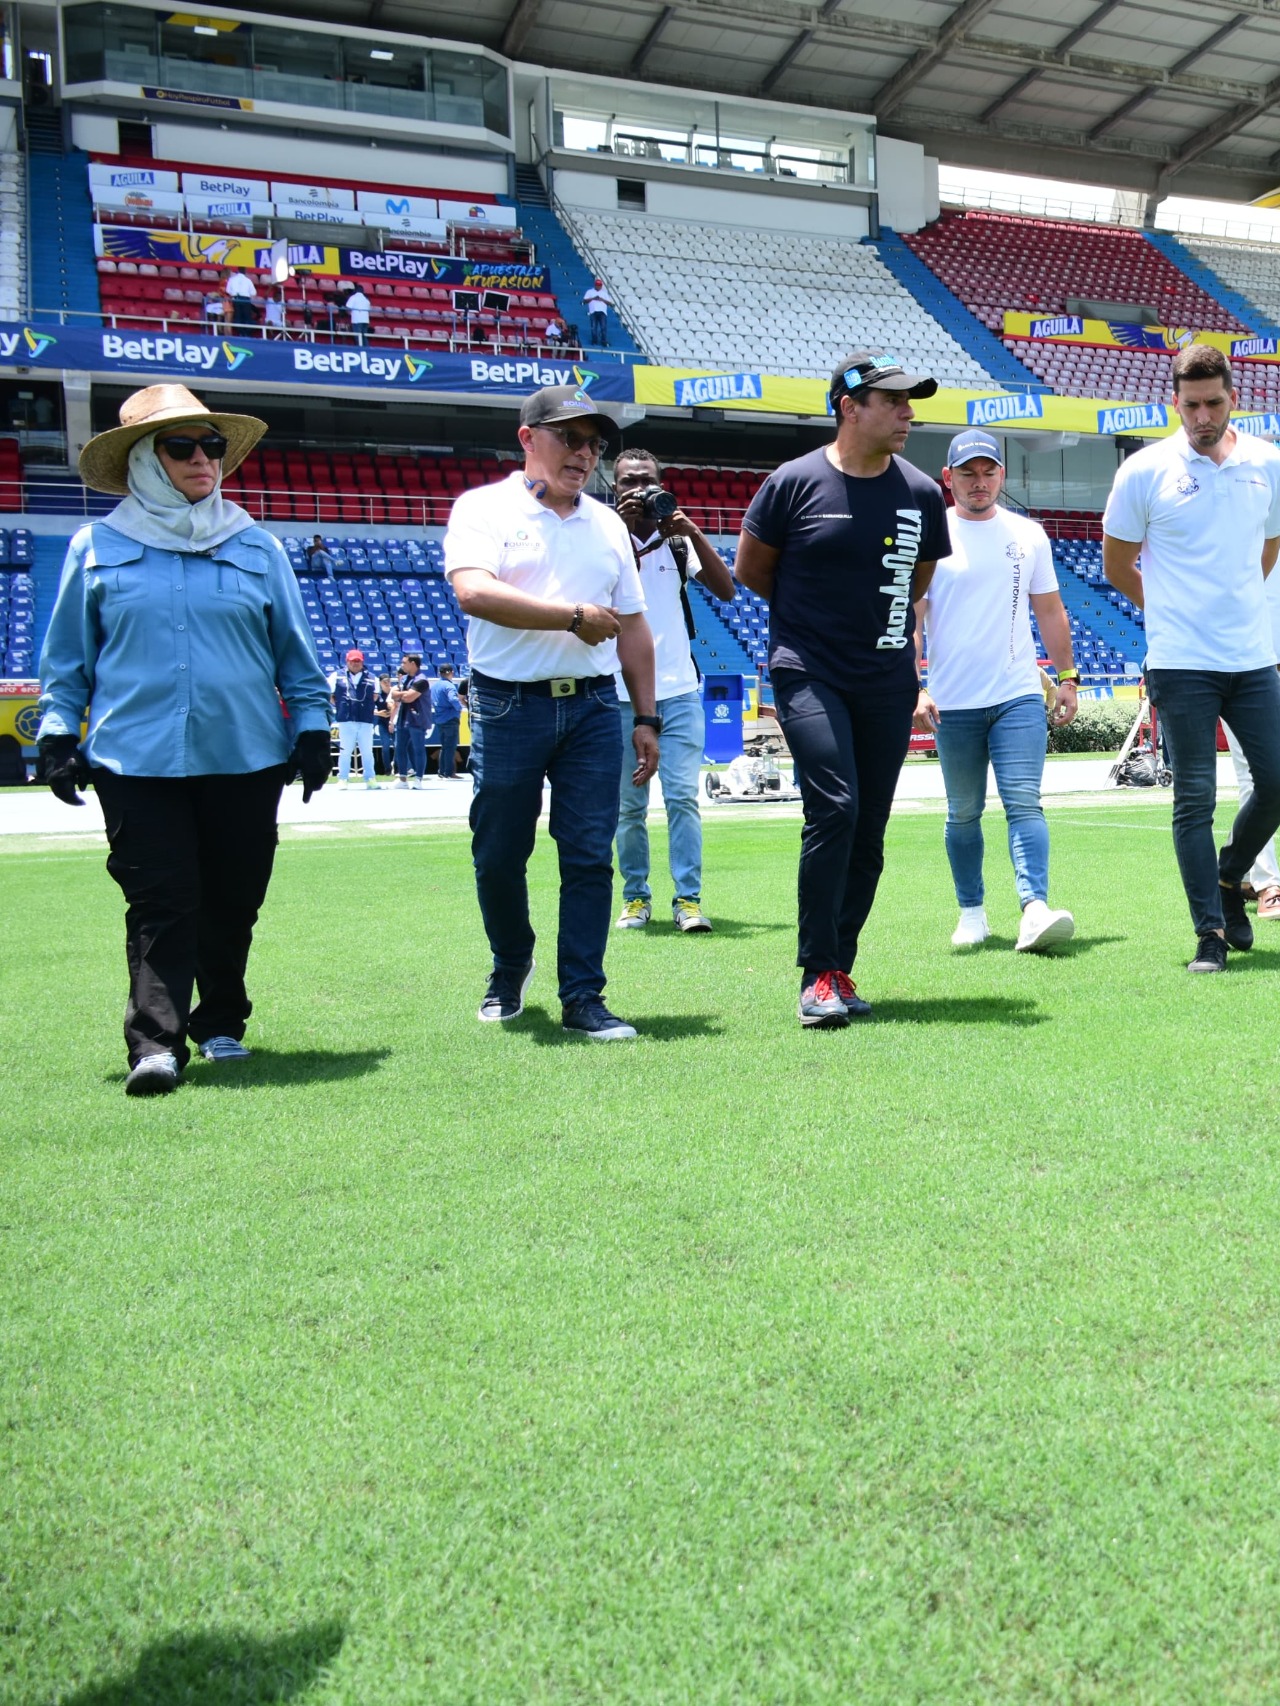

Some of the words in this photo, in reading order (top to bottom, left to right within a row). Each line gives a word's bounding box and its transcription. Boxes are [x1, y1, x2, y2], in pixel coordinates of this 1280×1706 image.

[112, 172, 153, 187] AGUILA
[201, 180, 250, 197] BetPlay
[208, 202, 250, 218] AGUILA
[288, 197, 339, 208] Bancolombia
[350, 252, 428, 278] BetPlay
[1032, 318, 1080, 337] AGUILA
[103, 334, 219, 369] BetPlay
[1232, 338, 1275, 357] AGUILA
[294, 349, 401, 381] BetPlay
[471, 360, 570, 386] BetPlay
[680, 374, 758, 405] AGUILA
[972, 396, 1039, 425] AGUILA
[1102, 405, 1164, 434] AGUILA
[1233, 415, 1280, 437] GUILA
